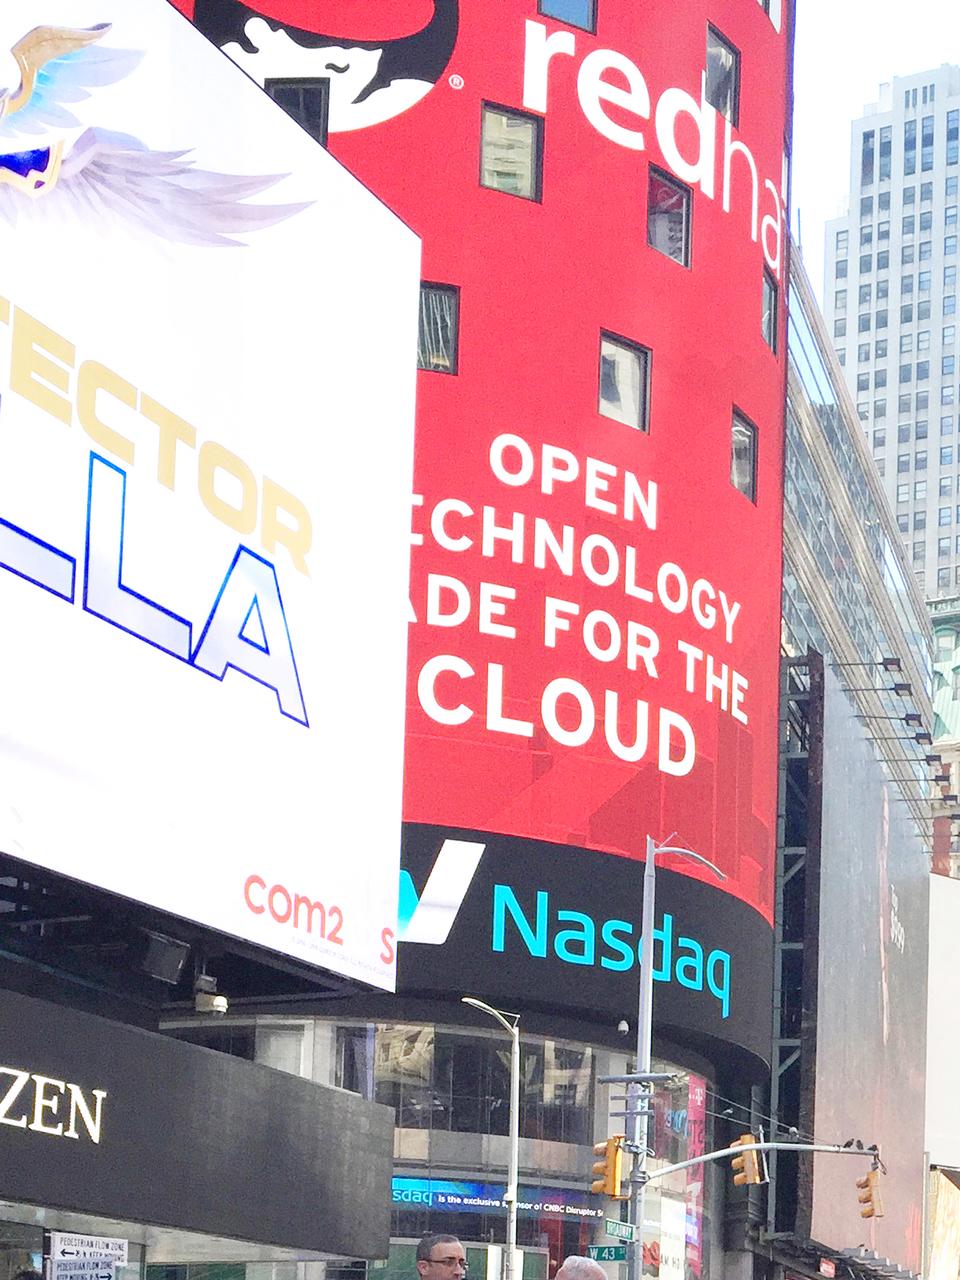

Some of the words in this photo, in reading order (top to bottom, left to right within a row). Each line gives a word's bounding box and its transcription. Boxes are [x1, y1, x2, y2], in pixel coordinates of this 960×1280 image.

[0, 296, 313, 579] ECTOR
[488, 433, 658, 531] OPEN
[416, 654, 697, 778] CLOUD
[543, 595, 660, 679] FOR
[677, 639, 750, 726] THE
[492, 884, 731, 1019] Nasdaq
[447, 1195, 462, 1204] the
[463, 1196, 500, 1207] exclusive
[590, 1248, 599, 1260] W
[602, 1248, 615, 1260] 43
